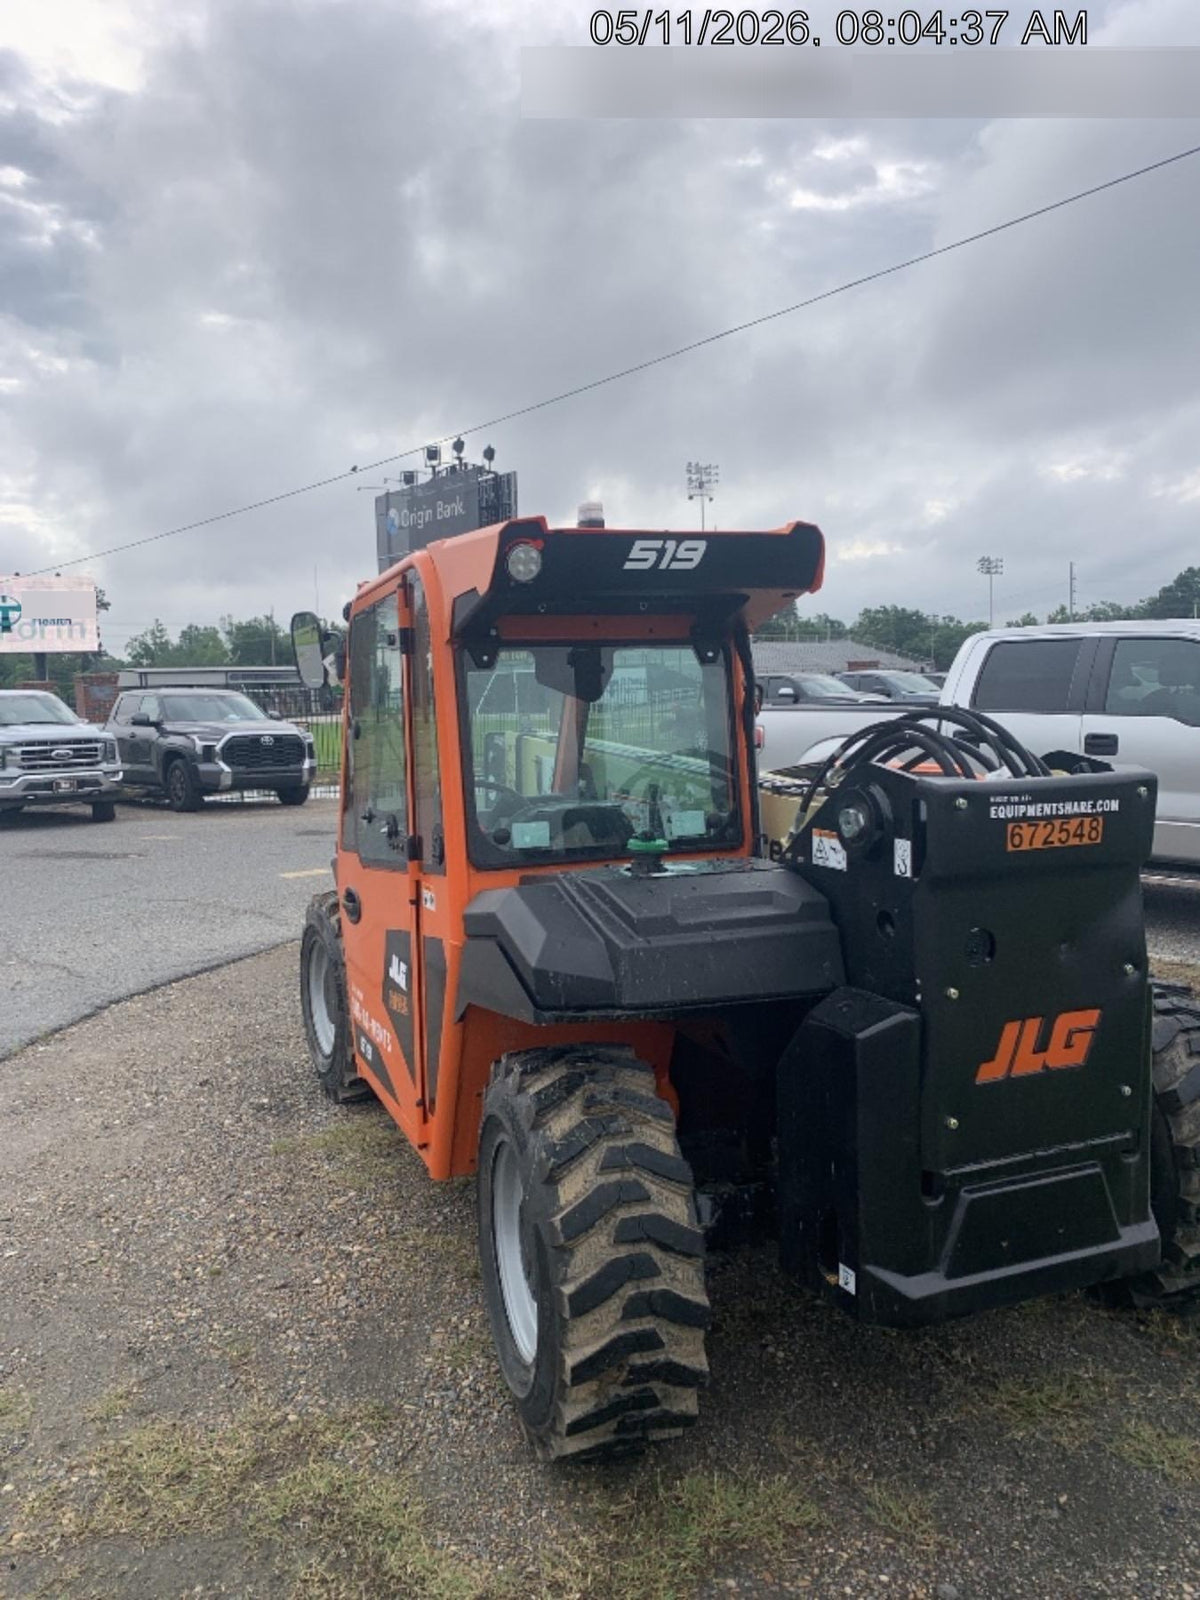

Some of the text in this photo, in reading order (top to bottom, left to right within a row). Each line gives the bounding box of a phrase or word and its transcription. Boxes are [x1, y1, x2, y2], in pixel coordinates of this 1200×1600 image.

[401, 495, 464, 529] Origin Bank
[623, 540, 707, 569] 519
[990, 799, 1120, 818] EQUIPMENTSHARE.COM
[1009, 818, 1101, 849] 672548
[975, 1009, 1101, 1084] JLG
